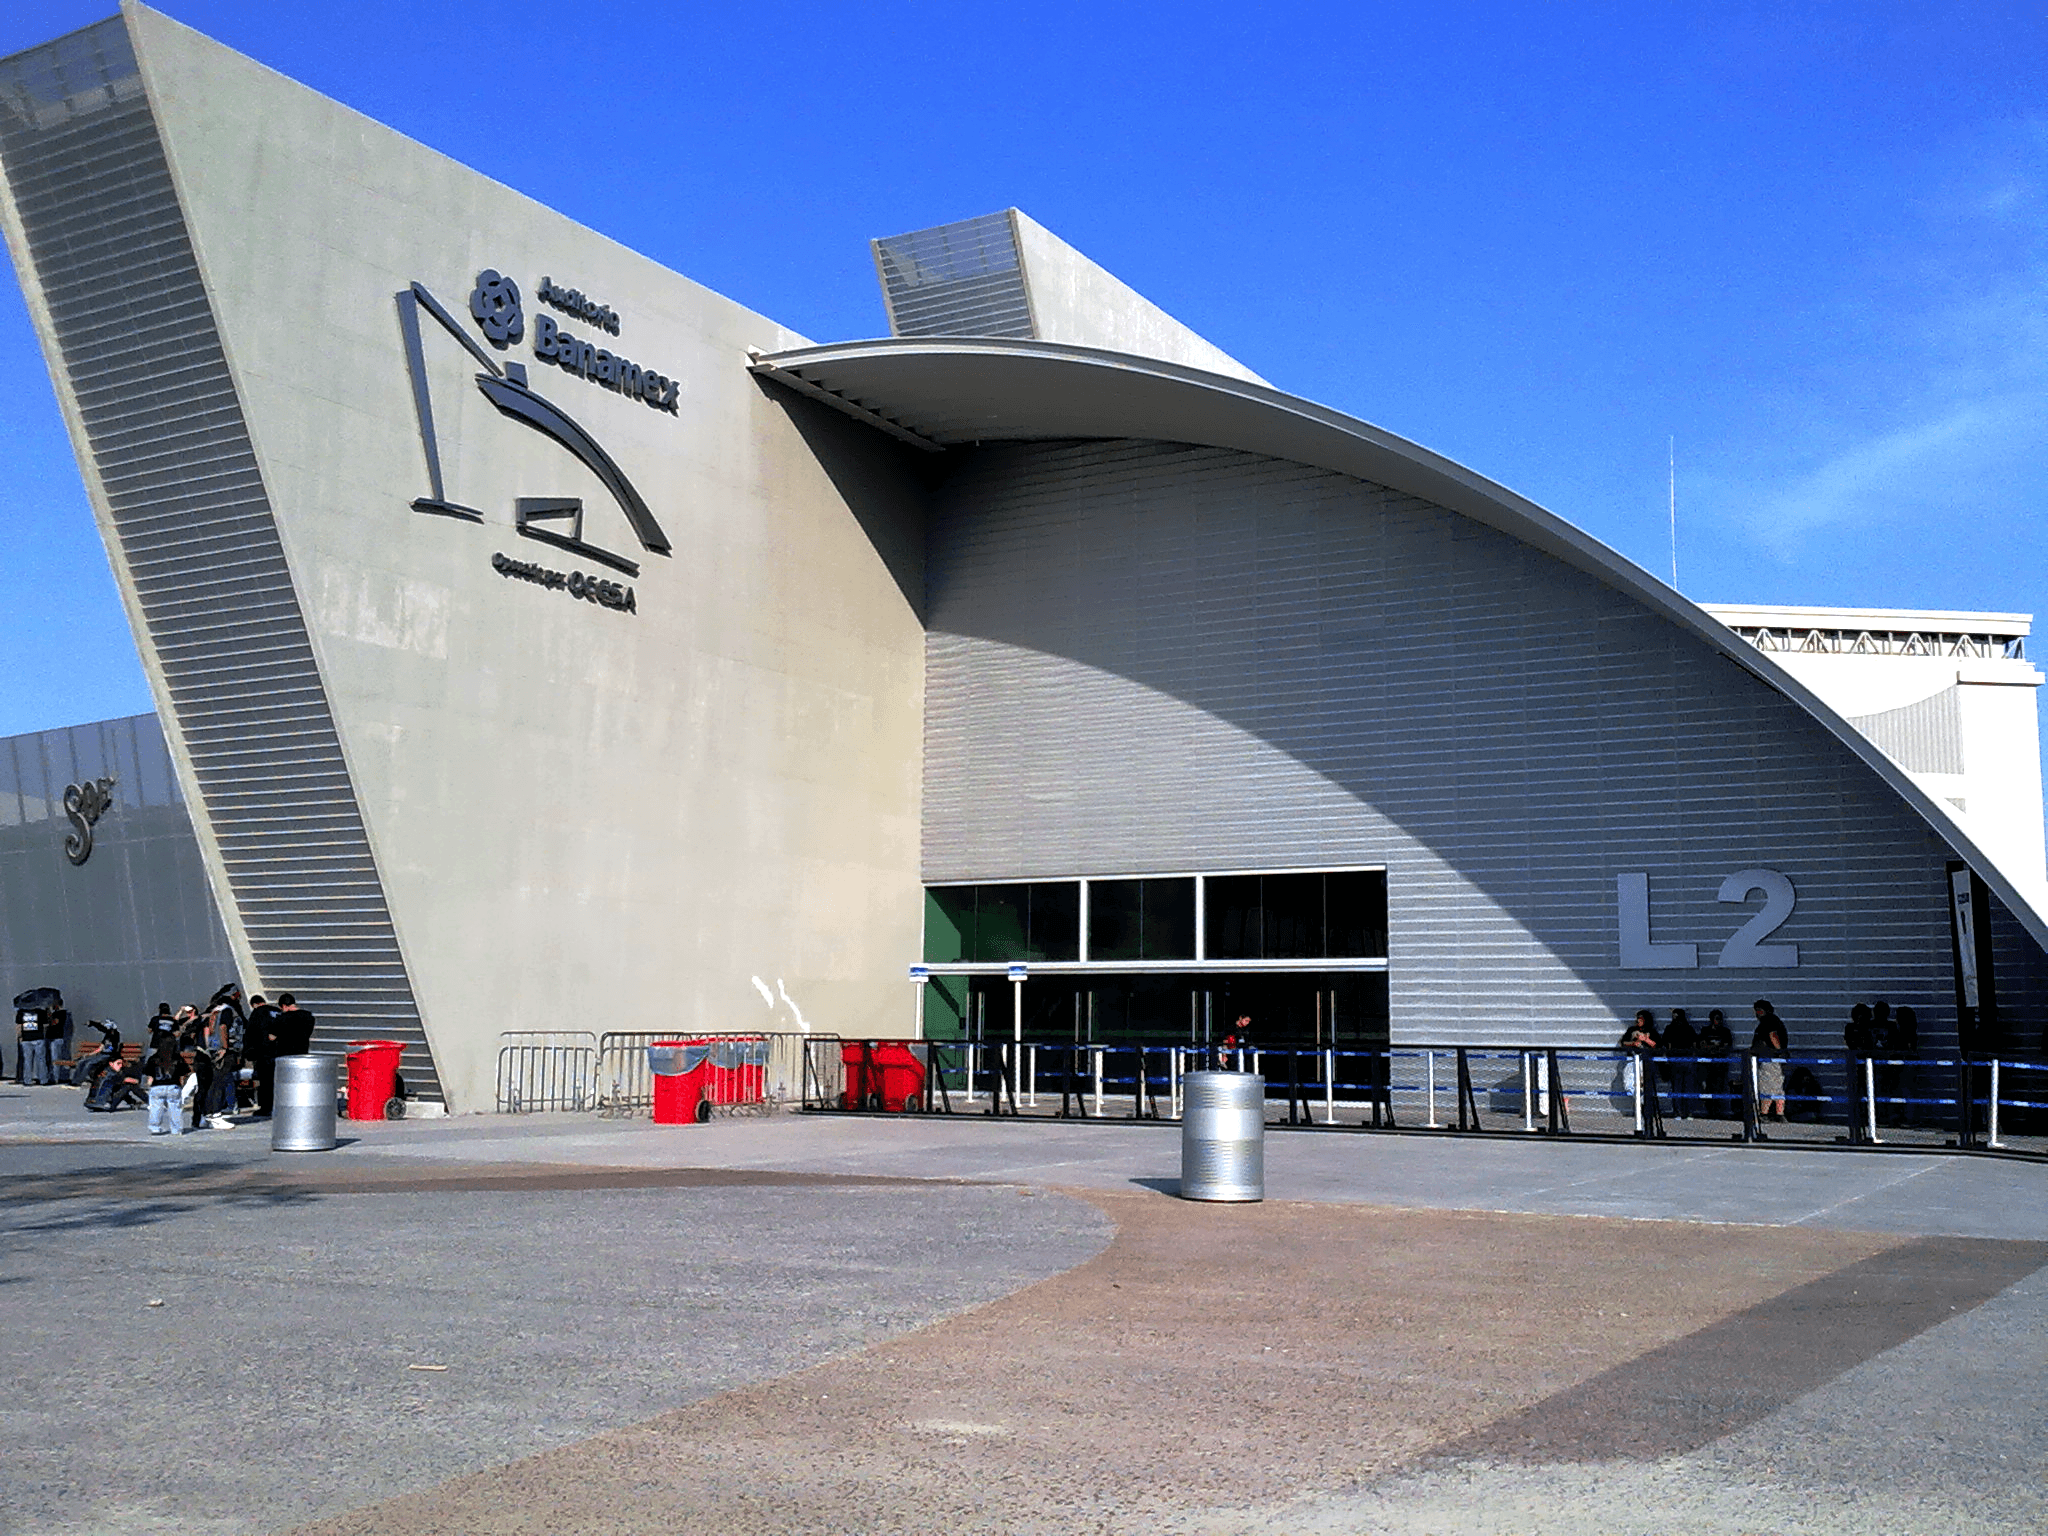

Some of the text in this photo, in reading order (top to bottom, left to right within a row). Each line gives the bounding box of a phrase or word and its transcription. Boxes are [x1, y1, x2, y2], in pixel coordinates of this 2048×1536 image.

[534, 313, 681, 418] Banamex
[567, 570, 637, 616] OCESA
[1617, 869, 1799, 969] L2
